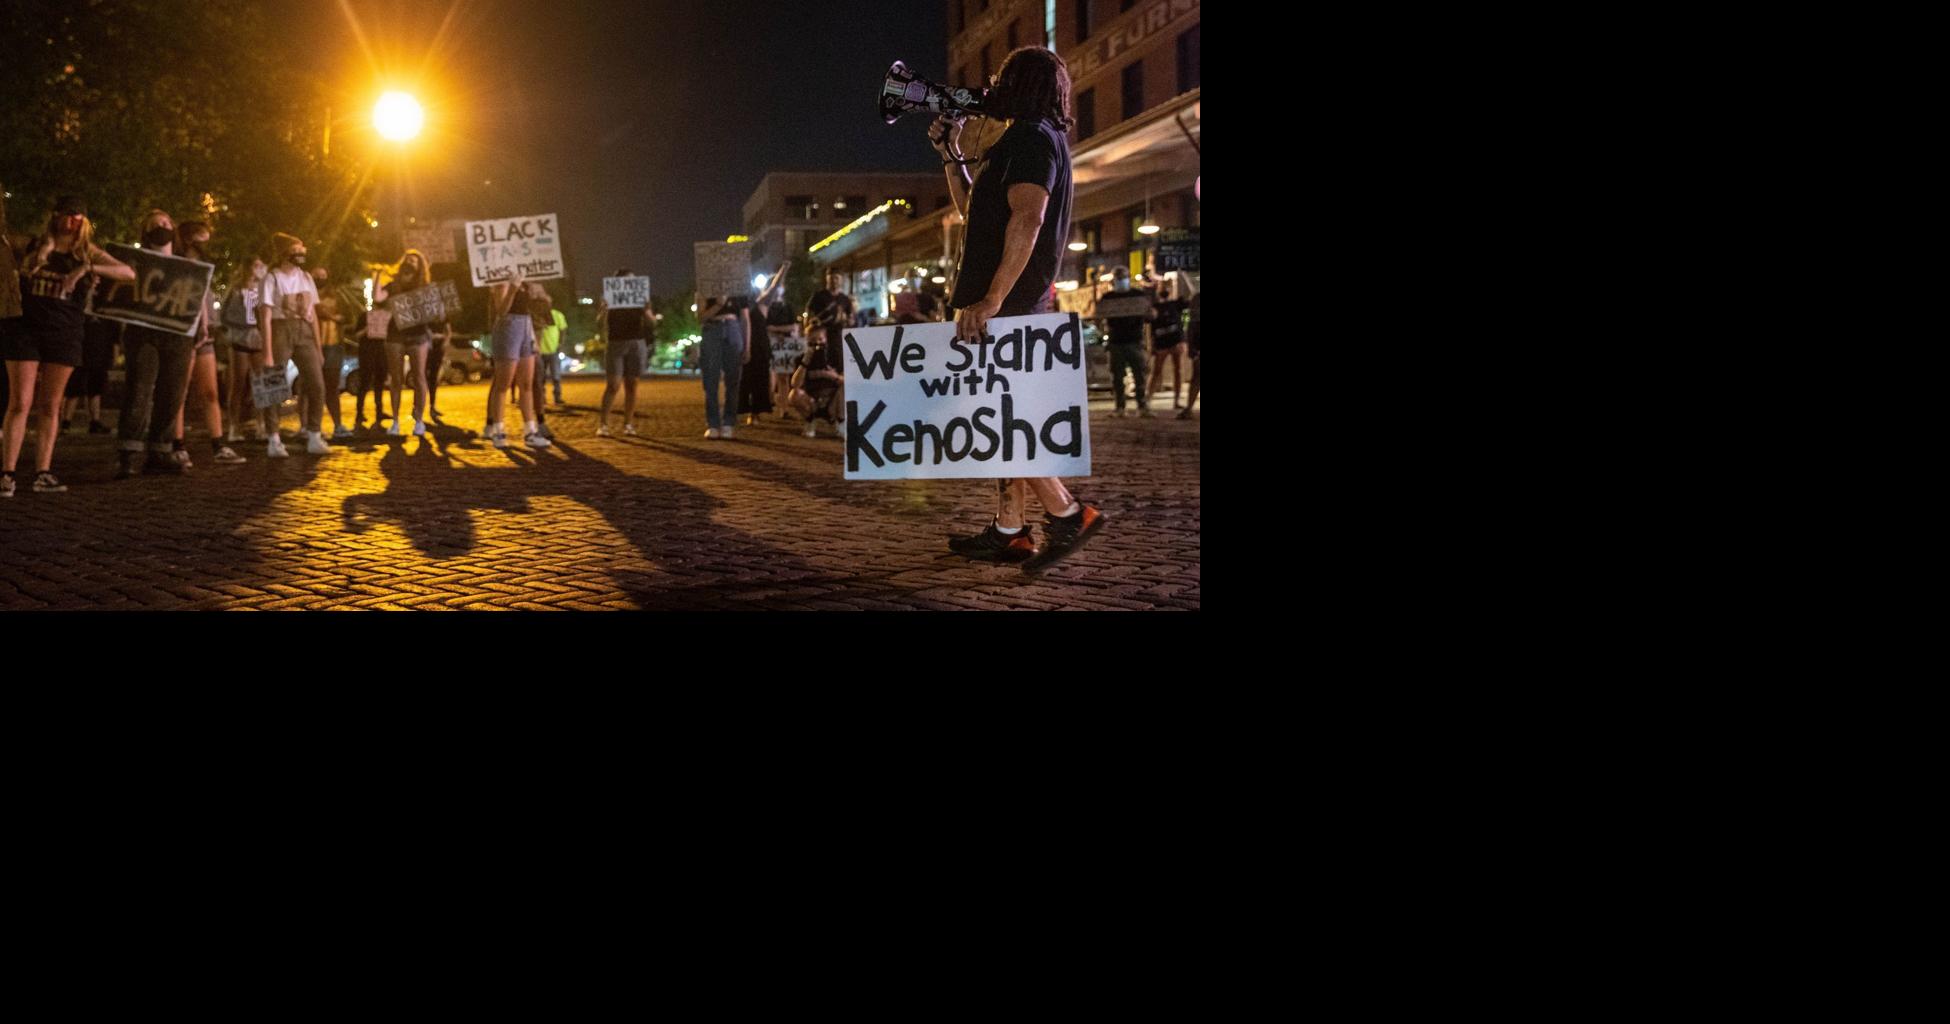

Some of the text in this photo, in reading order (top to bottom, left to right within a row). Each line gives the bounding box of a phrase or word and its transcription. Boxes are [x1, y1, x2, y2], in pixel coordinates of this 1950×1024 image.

[472, 219, 553, 245] BLACK
[476, 265, 513, 280] Lives
[605, 279, 648, 291] NO MORE
[612, 291, 646, 305] NAMES
[399, 308, 421, 323] NO
[771, 339, 803, 351] acob
[845, 326, 926, 380] We
[920, 363, 1010, 397] with
